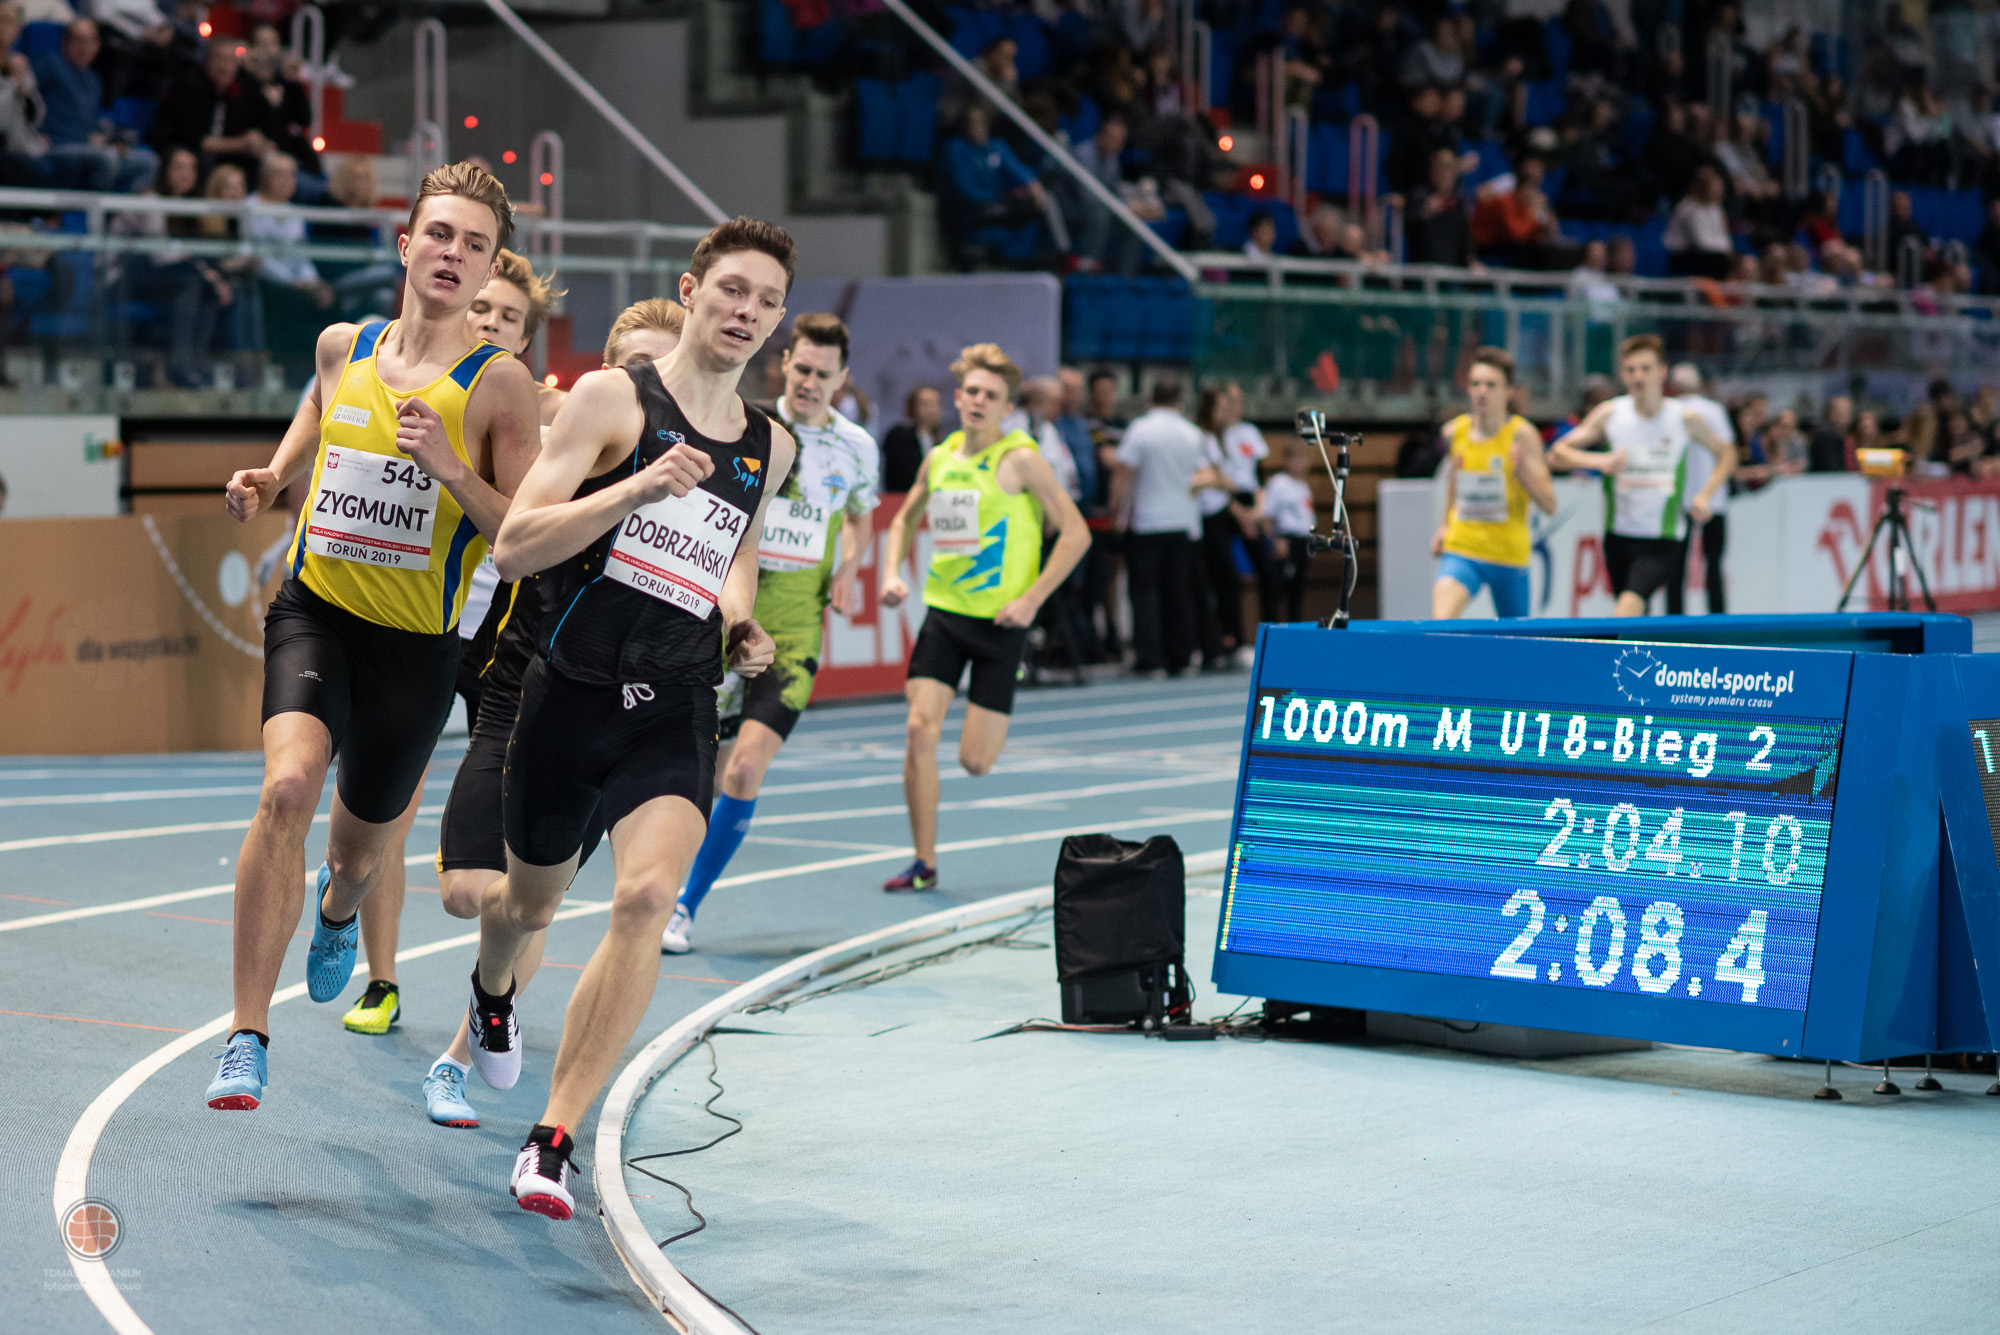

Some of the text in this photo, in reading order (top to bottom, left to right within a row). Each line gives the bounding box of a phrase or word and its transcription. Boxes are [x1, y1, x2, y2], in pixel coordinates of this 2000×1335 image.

[381, 461, 432, 491] 543
[315, 489, 429, 531] ZYGMUNT
[703, 498, 742, 538] 734
[789, 501, 823, 523] 801
[326, 541, 401, 565] TORUŃ 2019
[624, 512, 728, 580] DOBRZAŃSKI
[761, 525, 813, 548] UTNY
[631, 571, 700, 610] TORUŃ 2019
[1654, 663, 1795, 698] domtel-sport.pl
[1670, 694, 1773, 709] systemy pomiaru czasu
[1260, 695, 1777, 778] 1000m M U18-Bieg 2
[1535, 797, 1805, 886] 2:04.10
[1490, 888, 1769, 1004] 2:08.4
